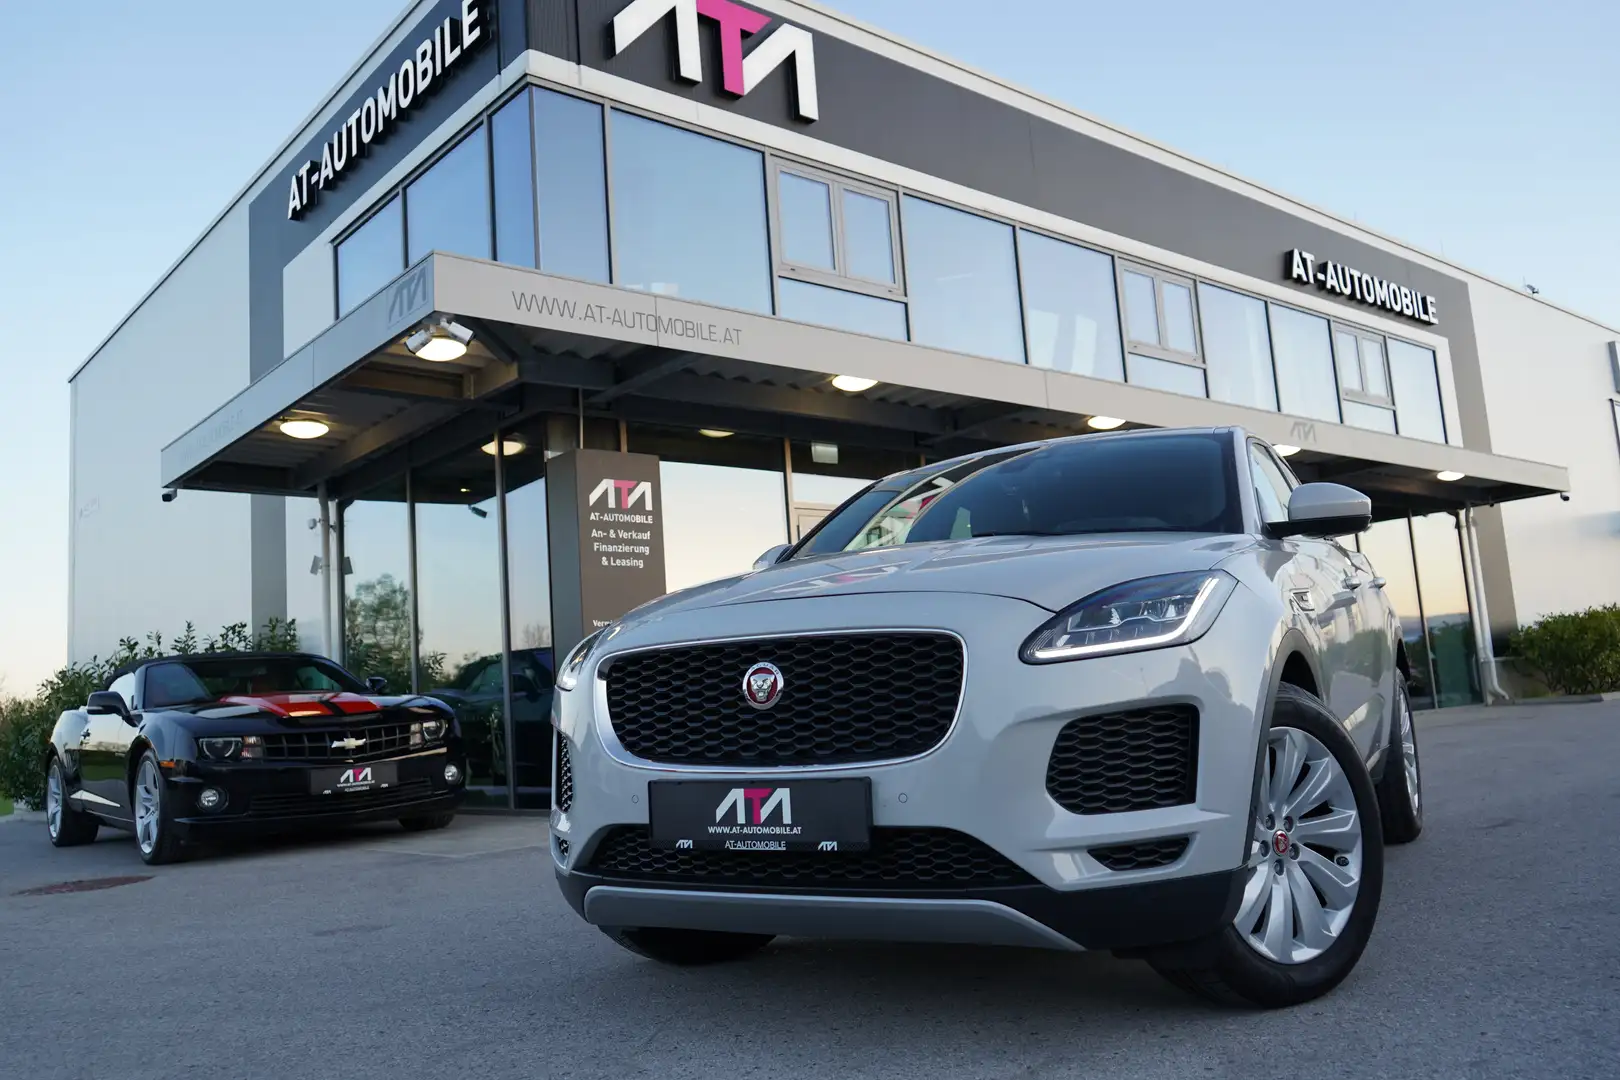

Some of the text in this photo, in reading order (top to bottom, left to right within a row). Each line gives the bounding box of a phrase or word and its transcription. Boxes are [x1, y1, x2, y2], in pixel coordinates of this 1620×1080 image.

[613, 0, 819, 121] ATA
[288, 0, 481, 220] AT-AUTOMOBILE
[1291, 248, 1439, 325] AT-AUTOMOBILE
[511, 290, 743, 346] WWW.AT-AUTOMOBILE.AT
[589, 478, 653, 511] ATA
[589, 512, 653, 524] AT-AUTOMOBILE
[591, 529, 651, 540] An- & Verkauf
[594, 543, 650, 555] Finanzierung
[601, 557, 644, 568] & Leasing
[340, 767, 371, 783] ATA
[716, 788, 792, 824] ATA
[708, 826, 801, 834] WWW.AT-AUTOMOBILE.AT
[725, 840, 786, 849] AT-AUTOMOBILE
